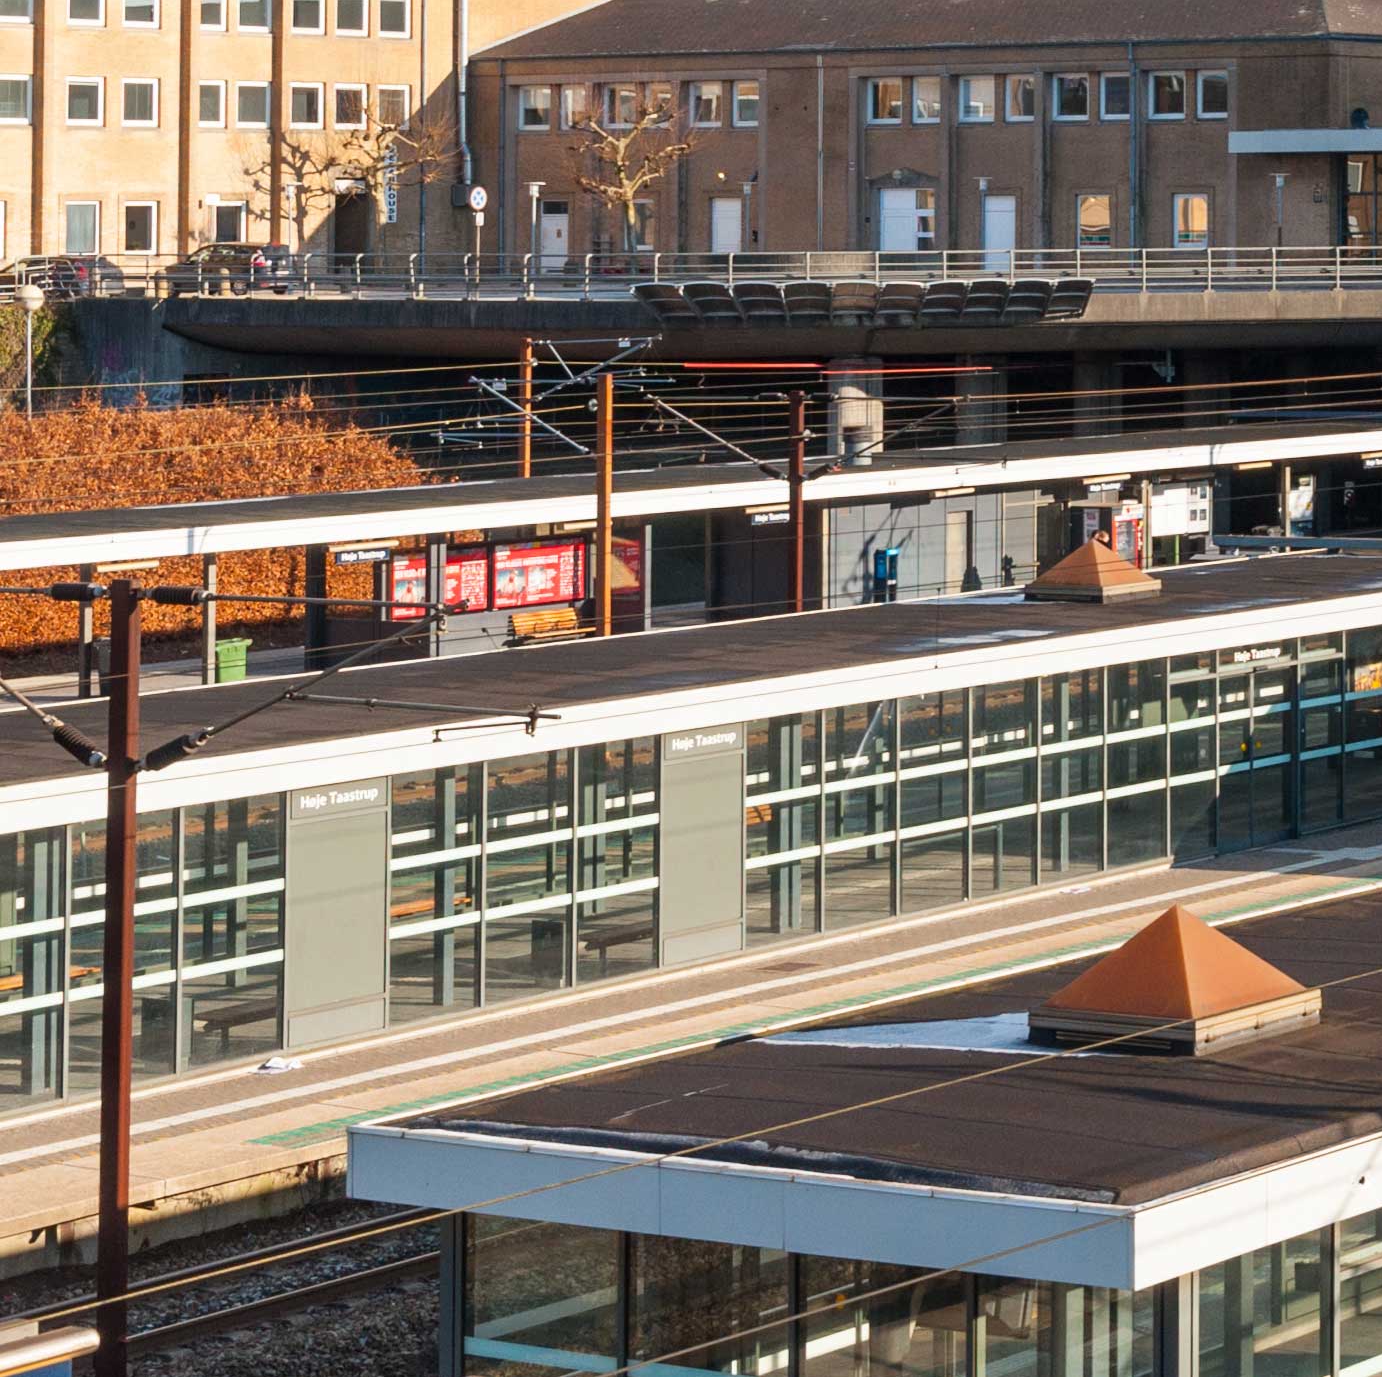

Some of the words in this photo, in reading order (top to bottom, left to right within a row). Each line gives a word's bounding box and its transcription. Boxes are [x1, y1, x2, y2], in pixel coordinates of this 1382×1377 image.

[672, 737, 694, 751] Høje
[695, 732, 736, 746] Taastrup
[300, 794, 327, 810] Høje
[329, 788, 379, 804] Taastrup
